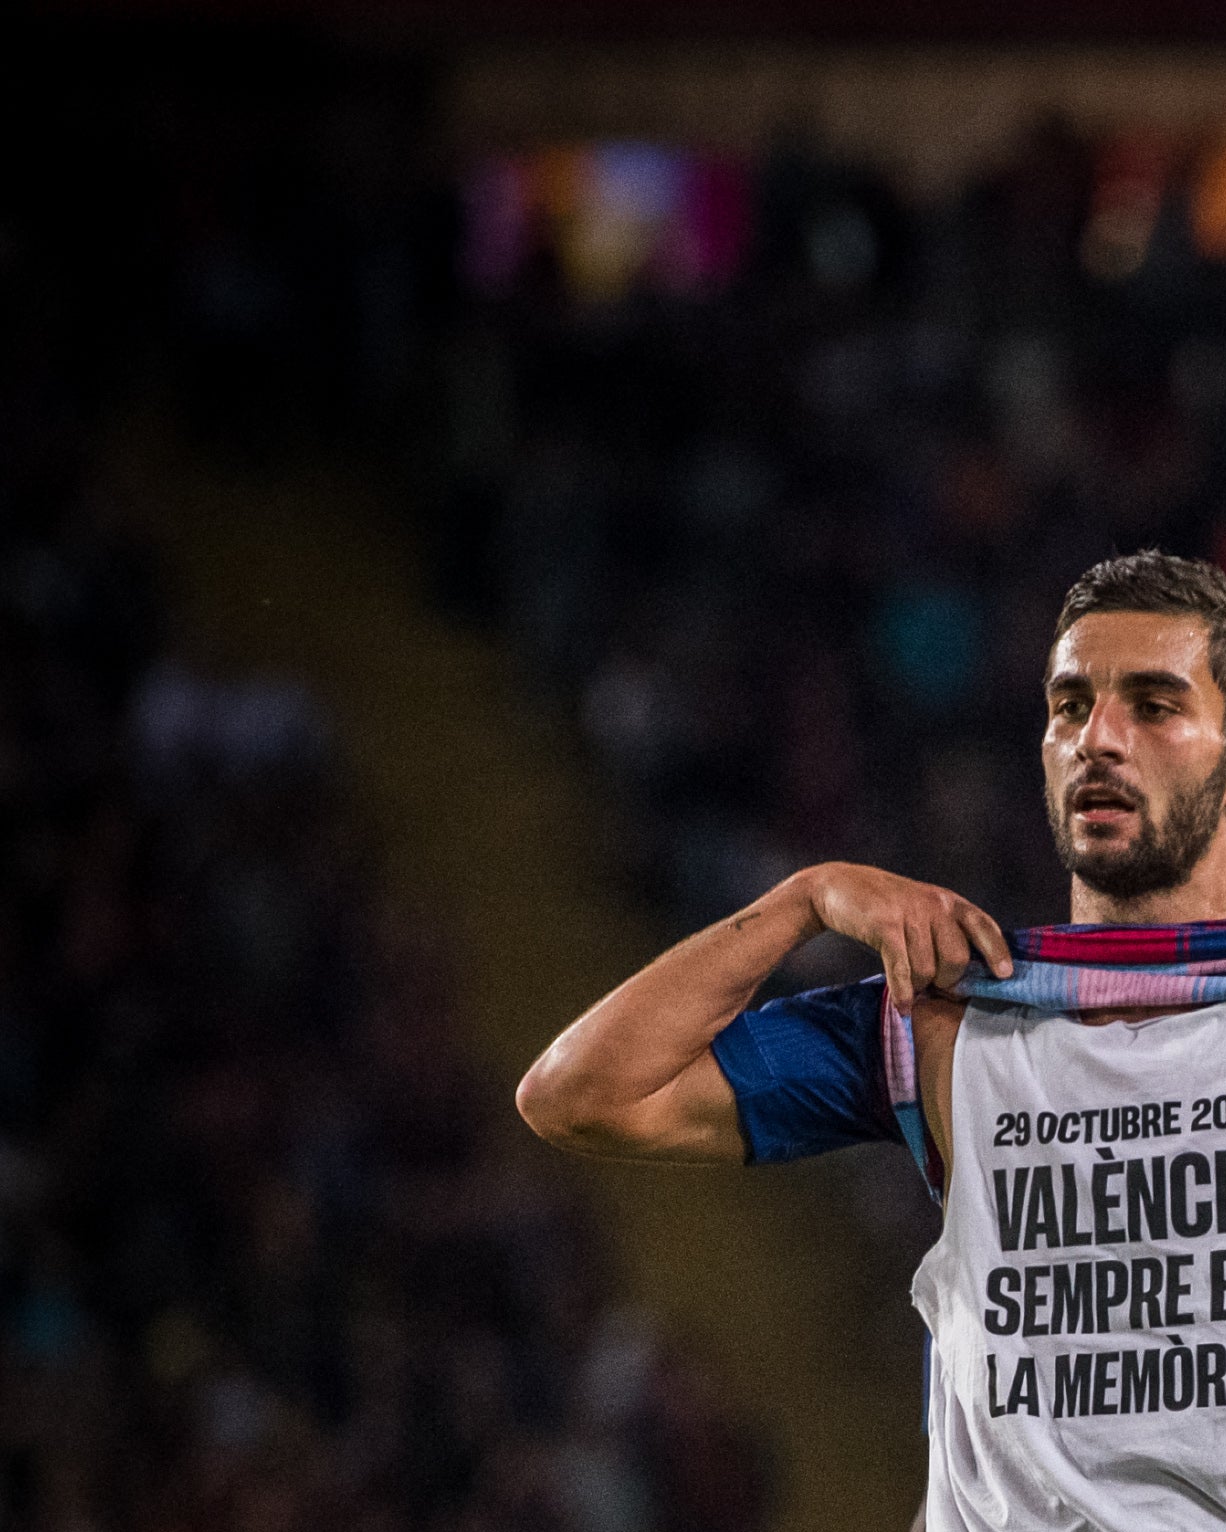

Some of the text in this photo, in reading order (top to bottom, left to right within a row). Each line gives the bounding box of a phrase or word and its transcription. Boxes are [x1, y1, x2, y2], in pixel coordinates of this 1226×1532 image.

[992, 1111, 1032, 1148] 29
[1036, 1101, 1183, 1145] OCTUBRE
[984, 1253, 1197, 1338] SEMPRE
[986, 1352, 1041, 1420] LA
